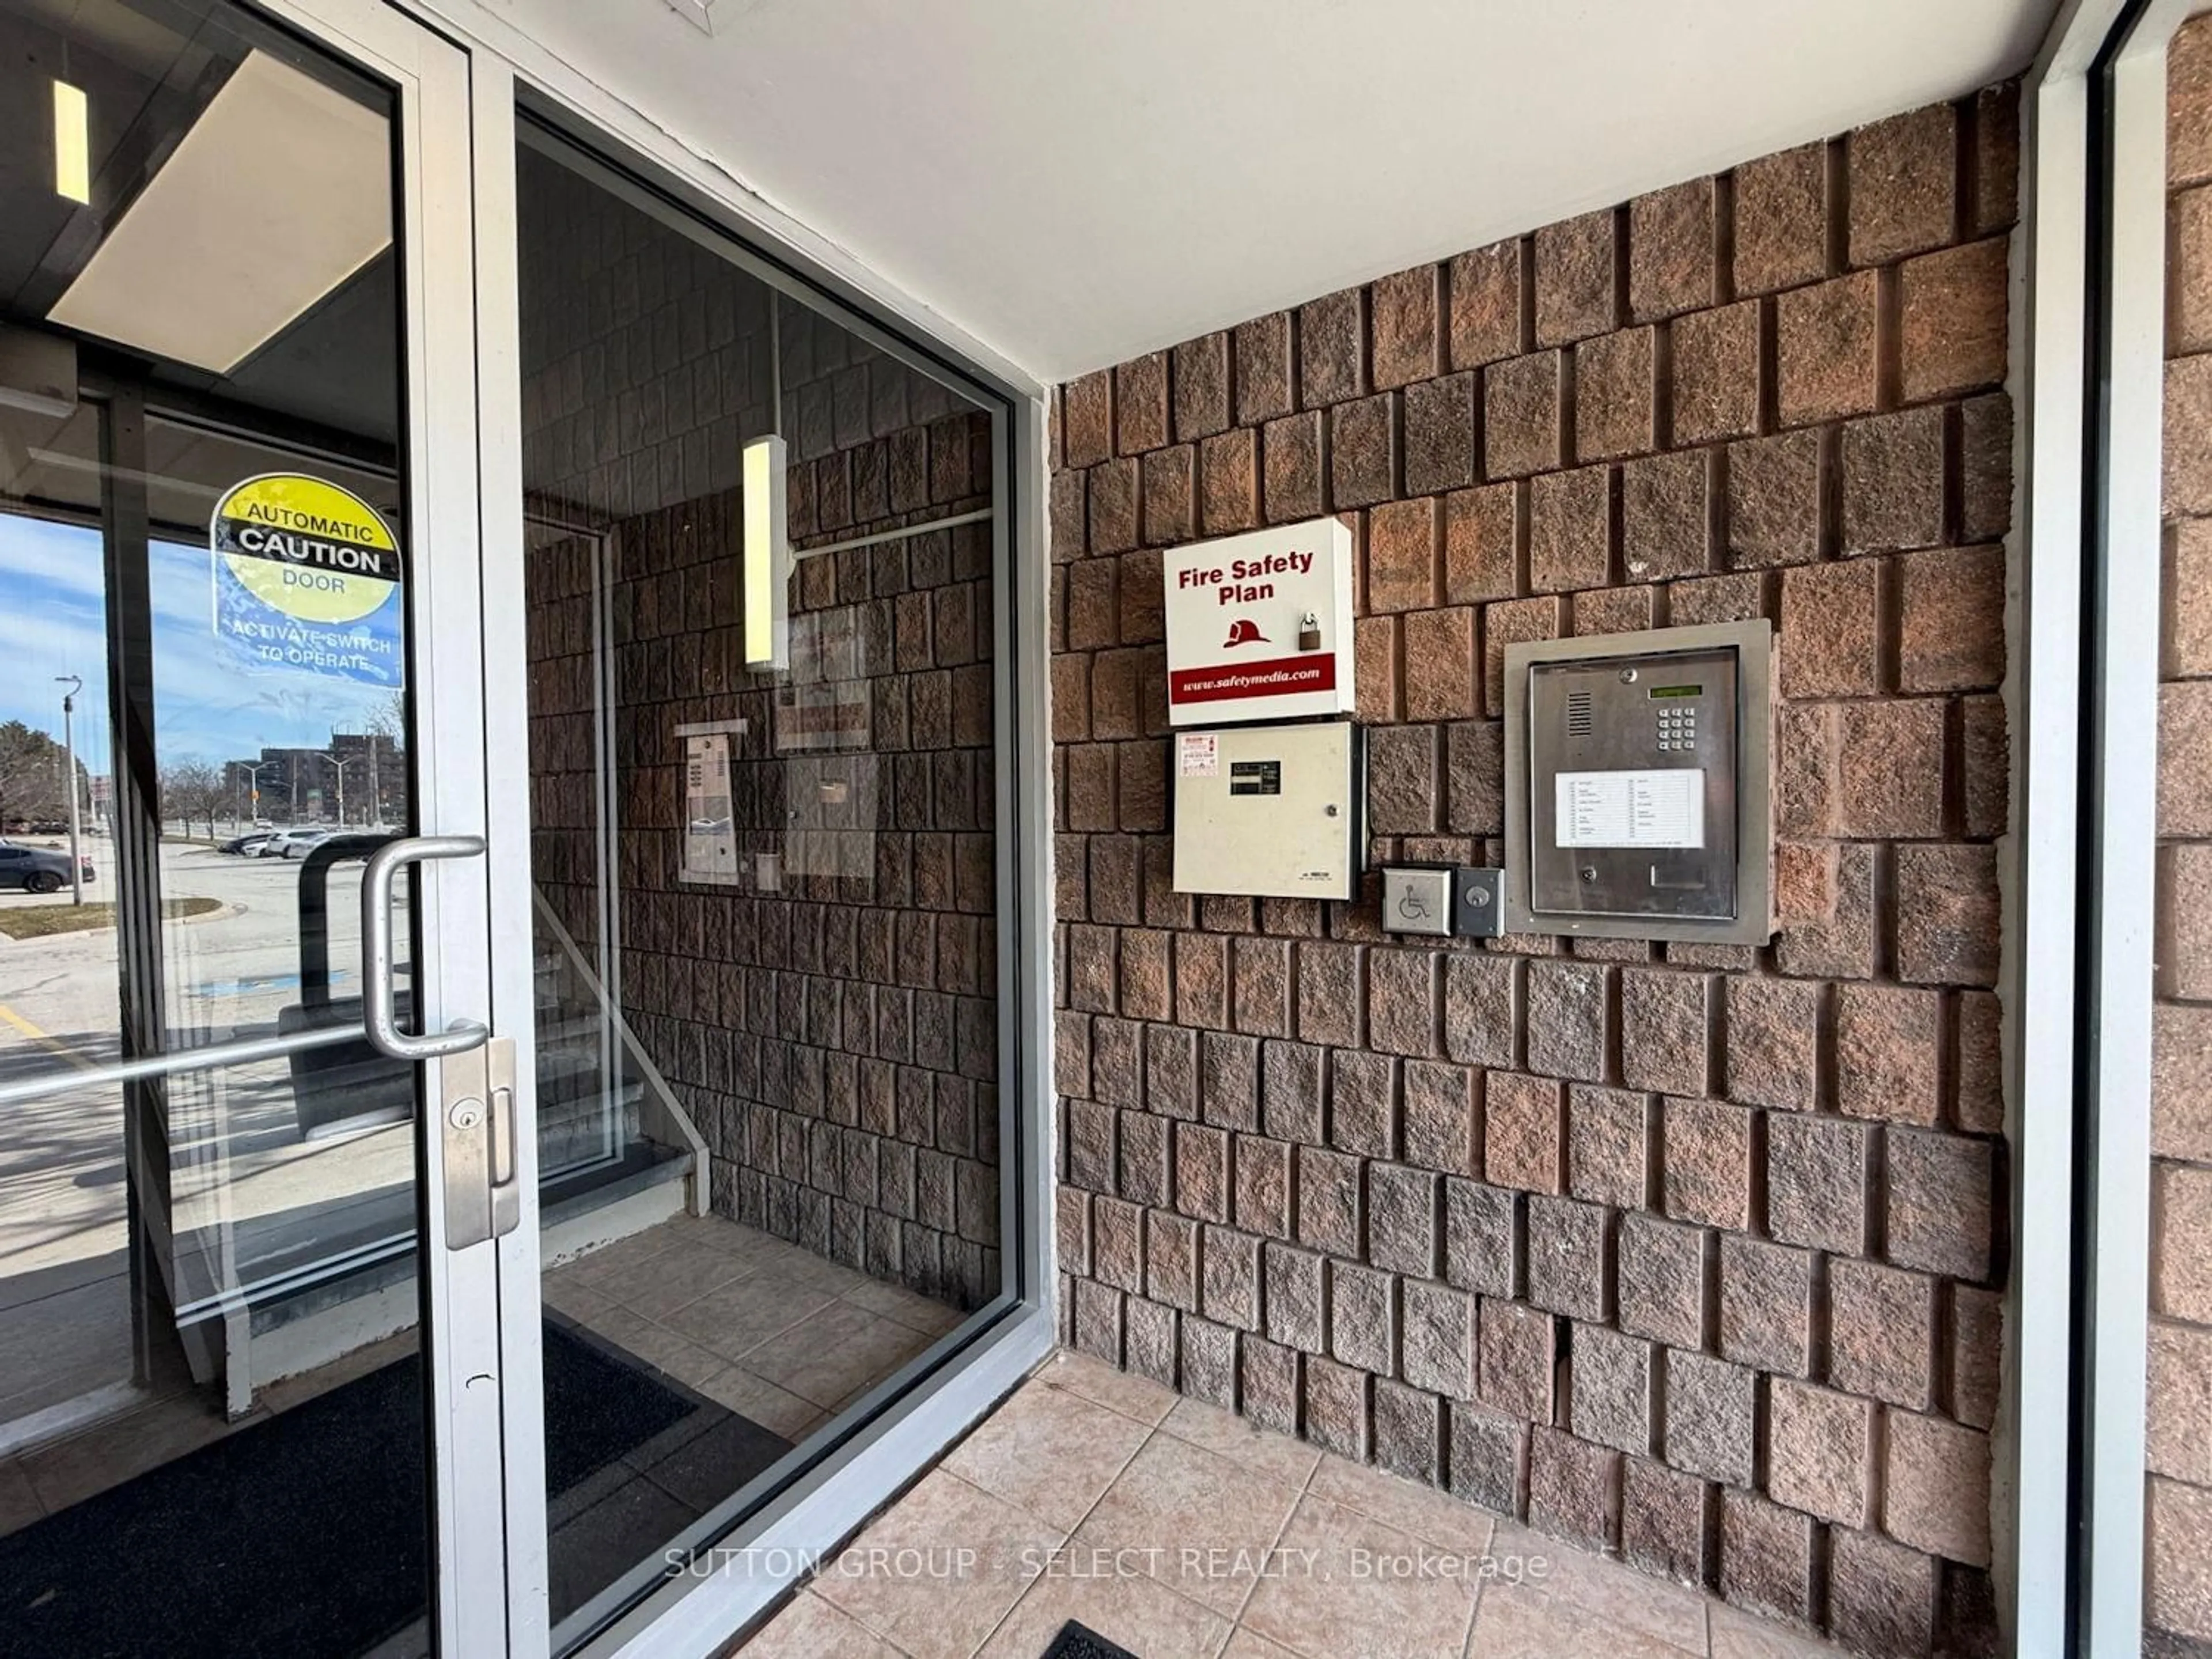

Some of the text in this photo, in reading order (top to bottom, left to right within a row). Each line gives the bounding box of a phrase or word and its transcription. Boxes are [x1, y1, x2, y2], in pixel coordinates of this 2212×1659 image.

[247, 503, 374, 541] AUTOMATIC
[238, 528, 380, 573] CAUTION
[283, 569, 345, 594] DOOR
[1179, 551, 1313, 589] Fire Safety
[1219, 582, 1274, 605] Plan
[232, 619, 391, 654] ACTIVATE SWITCH
[259, 645, 368, 670] TO OPERATE
[1183, 668, 1320, 692] www.safetymedia.com
